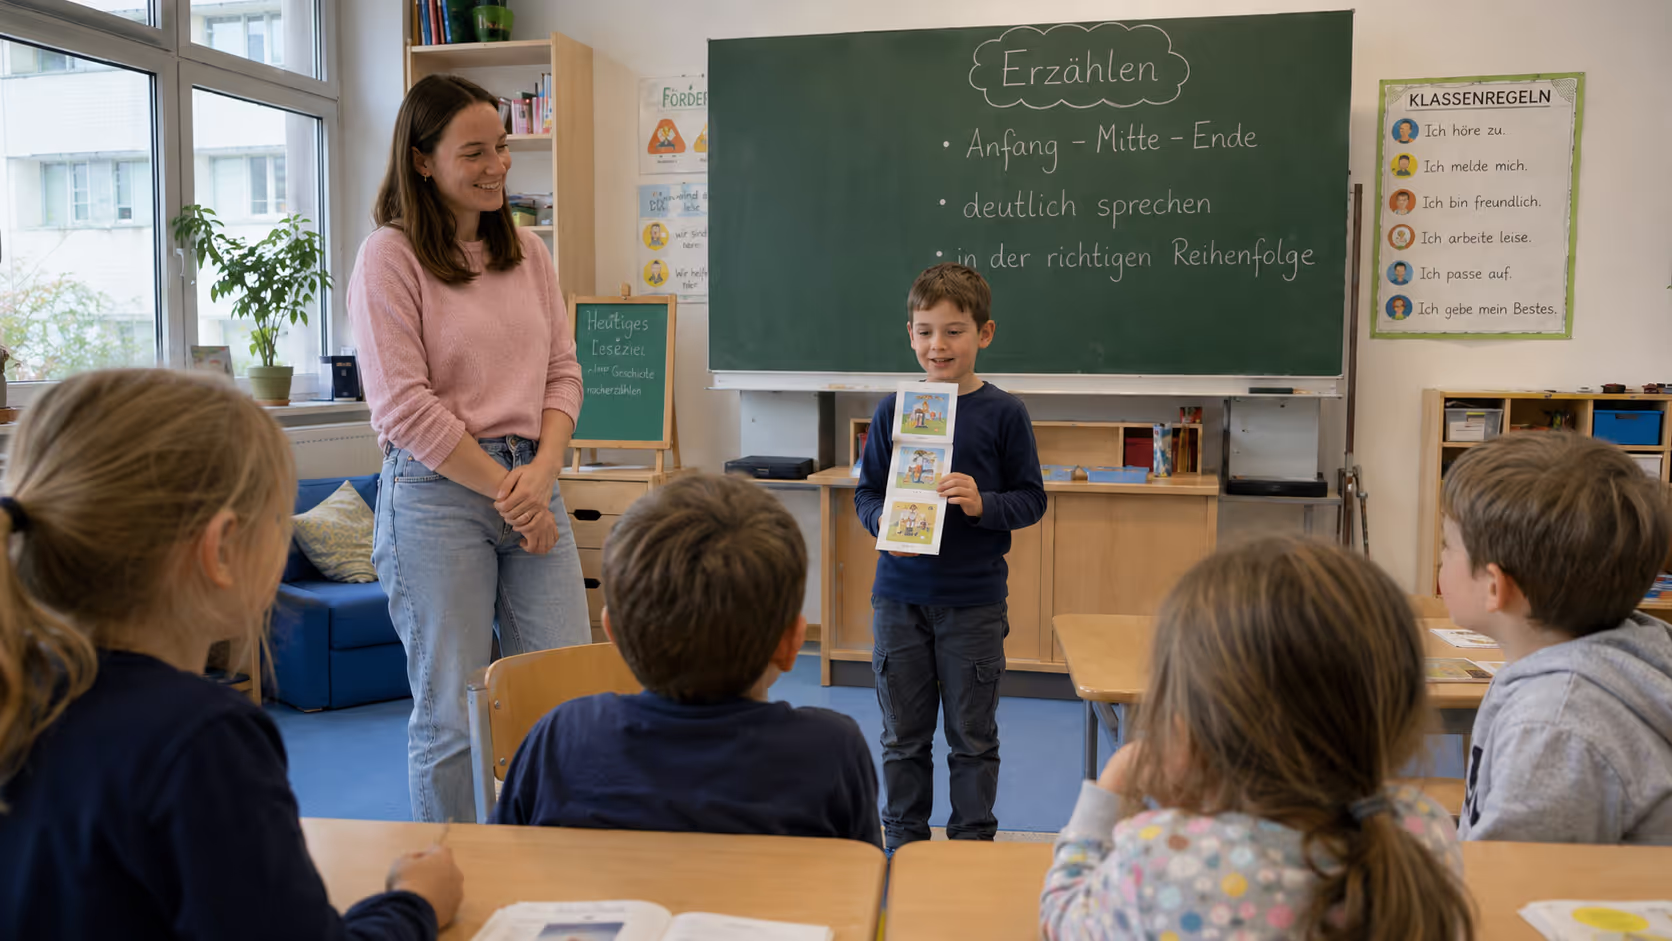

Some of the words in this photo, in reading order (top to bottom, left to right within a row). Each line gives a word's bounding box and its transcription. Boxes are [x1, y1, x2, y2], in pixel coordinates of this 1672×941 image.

[1002, 49, 1159, 87] Erzählen
[1409, 89, 1551, 107] KLASSENREGELN
[1424, 124, 1446, 138] Ich
[1452, 124, 1481, 136] höre
[1487, 126, 1506, 136] zu.
[966, 127, 1058, 174] Anfang
[1096, 122, 1161, 153] Mitte
[1193, 120, 1258, 150] Ende
[1424, 159, 1445, 173] Ich
[1451, 160, 1489, 172] melde
[1495, 159, 1528, 172] mich.
[963, 189, 1077, 219] deutlich
[1097, 189, 1211, 230] sprechen
[1422, 195, 1443, 209] Ich
[1449, 194, 1468, 208] bin
[1474, 194, 1542, 211] freundlich.
[1420, 231, 1442, 244] Ich
[1448, 231, 1494, 244] arbeite
[1499, 231, 1532, 244] leise.
[957, 247, 977, 269] in
[990, 242, 1031, 269] der
[1047, 241, 1152, 282] richtigen
[1172, 237, 1316, 282] Reihenfolge
[1419, 266, 1441, 280] Ich
[1446, 269, 1482, 284] passe
[1488, 266, 1513, 281] auf.
[1417, 302, 1439, 315] Ich
[1444, 302, 1473, 320] gebe
[1478, 303, 1508, 315] mein
[1513, 301, 1558, 315] Bestes.
[586, 309, 649, 340] Heutiges
